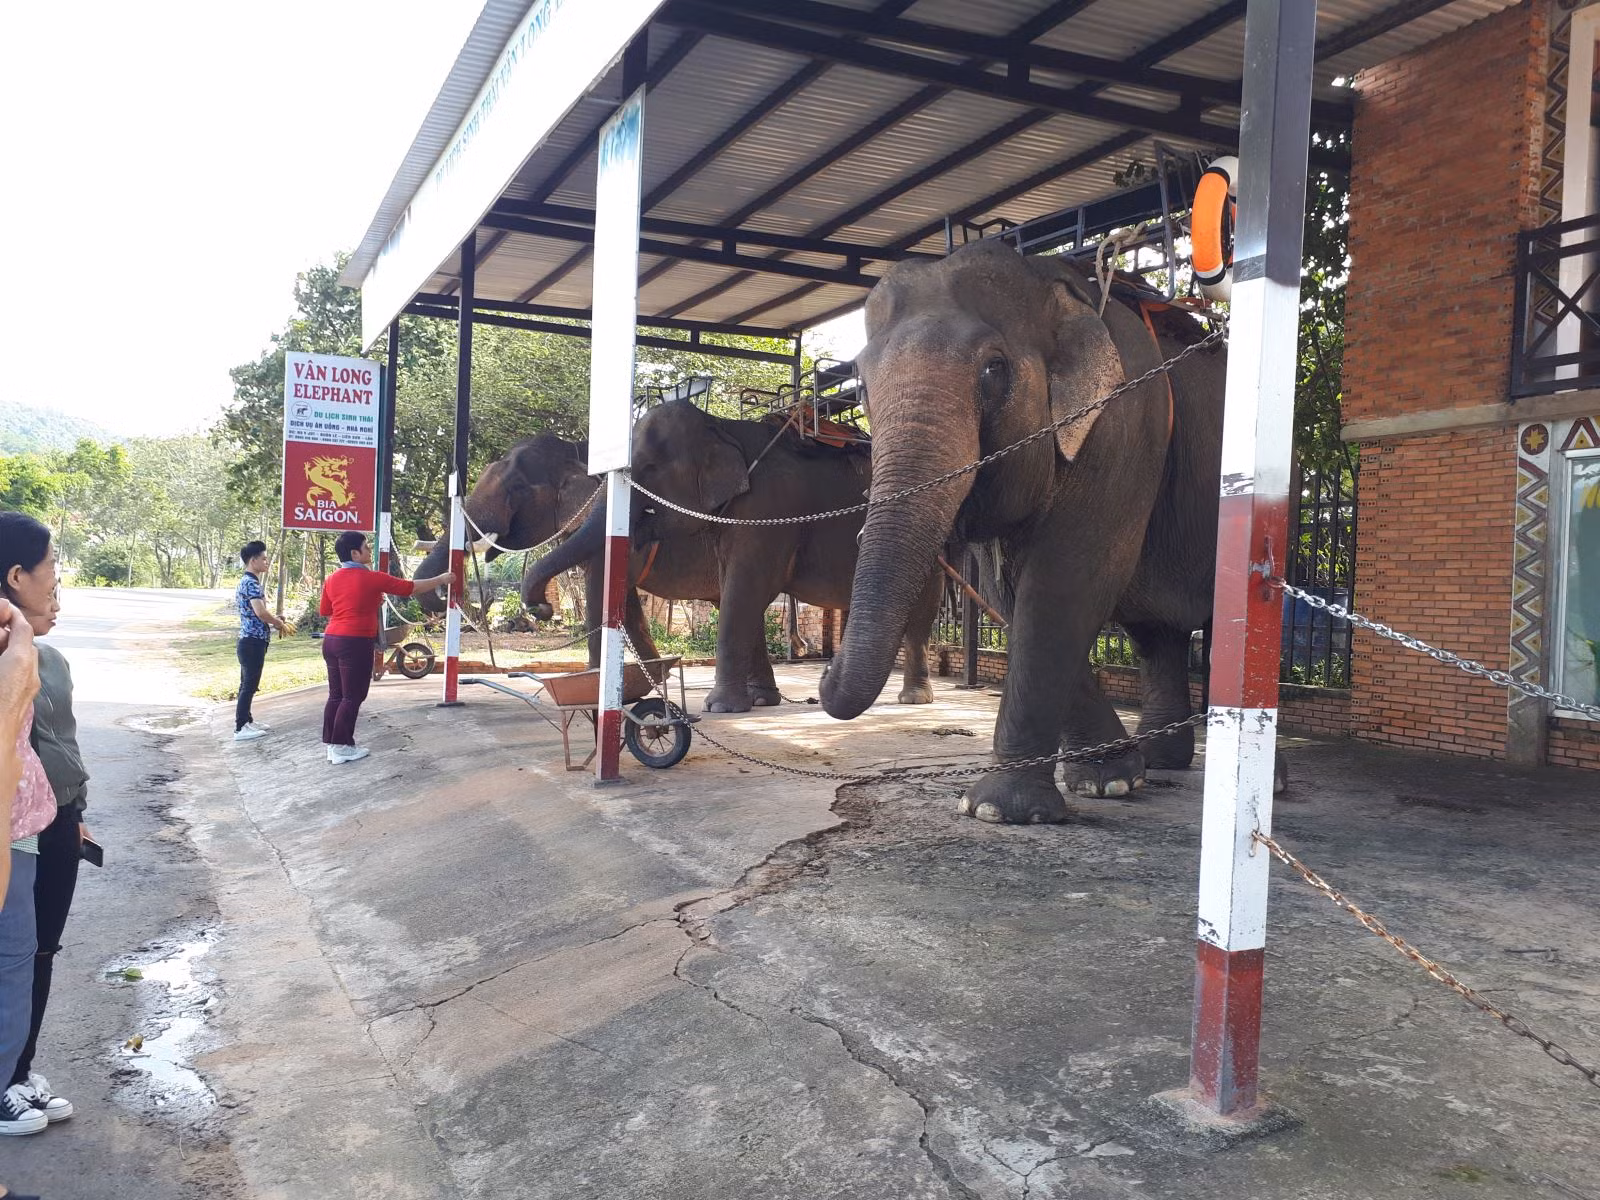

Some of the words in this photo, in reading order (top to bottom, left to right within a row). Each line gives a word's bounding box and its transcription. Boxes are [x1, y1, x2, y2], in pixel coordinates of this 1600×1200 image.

[294, 360, 327, 381] VÂN
[332, 367, 372, 385] LONG
[294, 383, 373, 405] ELEPHANT
[317, 499, 337, 509] BIA
[294, 507, 359, 524] SAIGON
